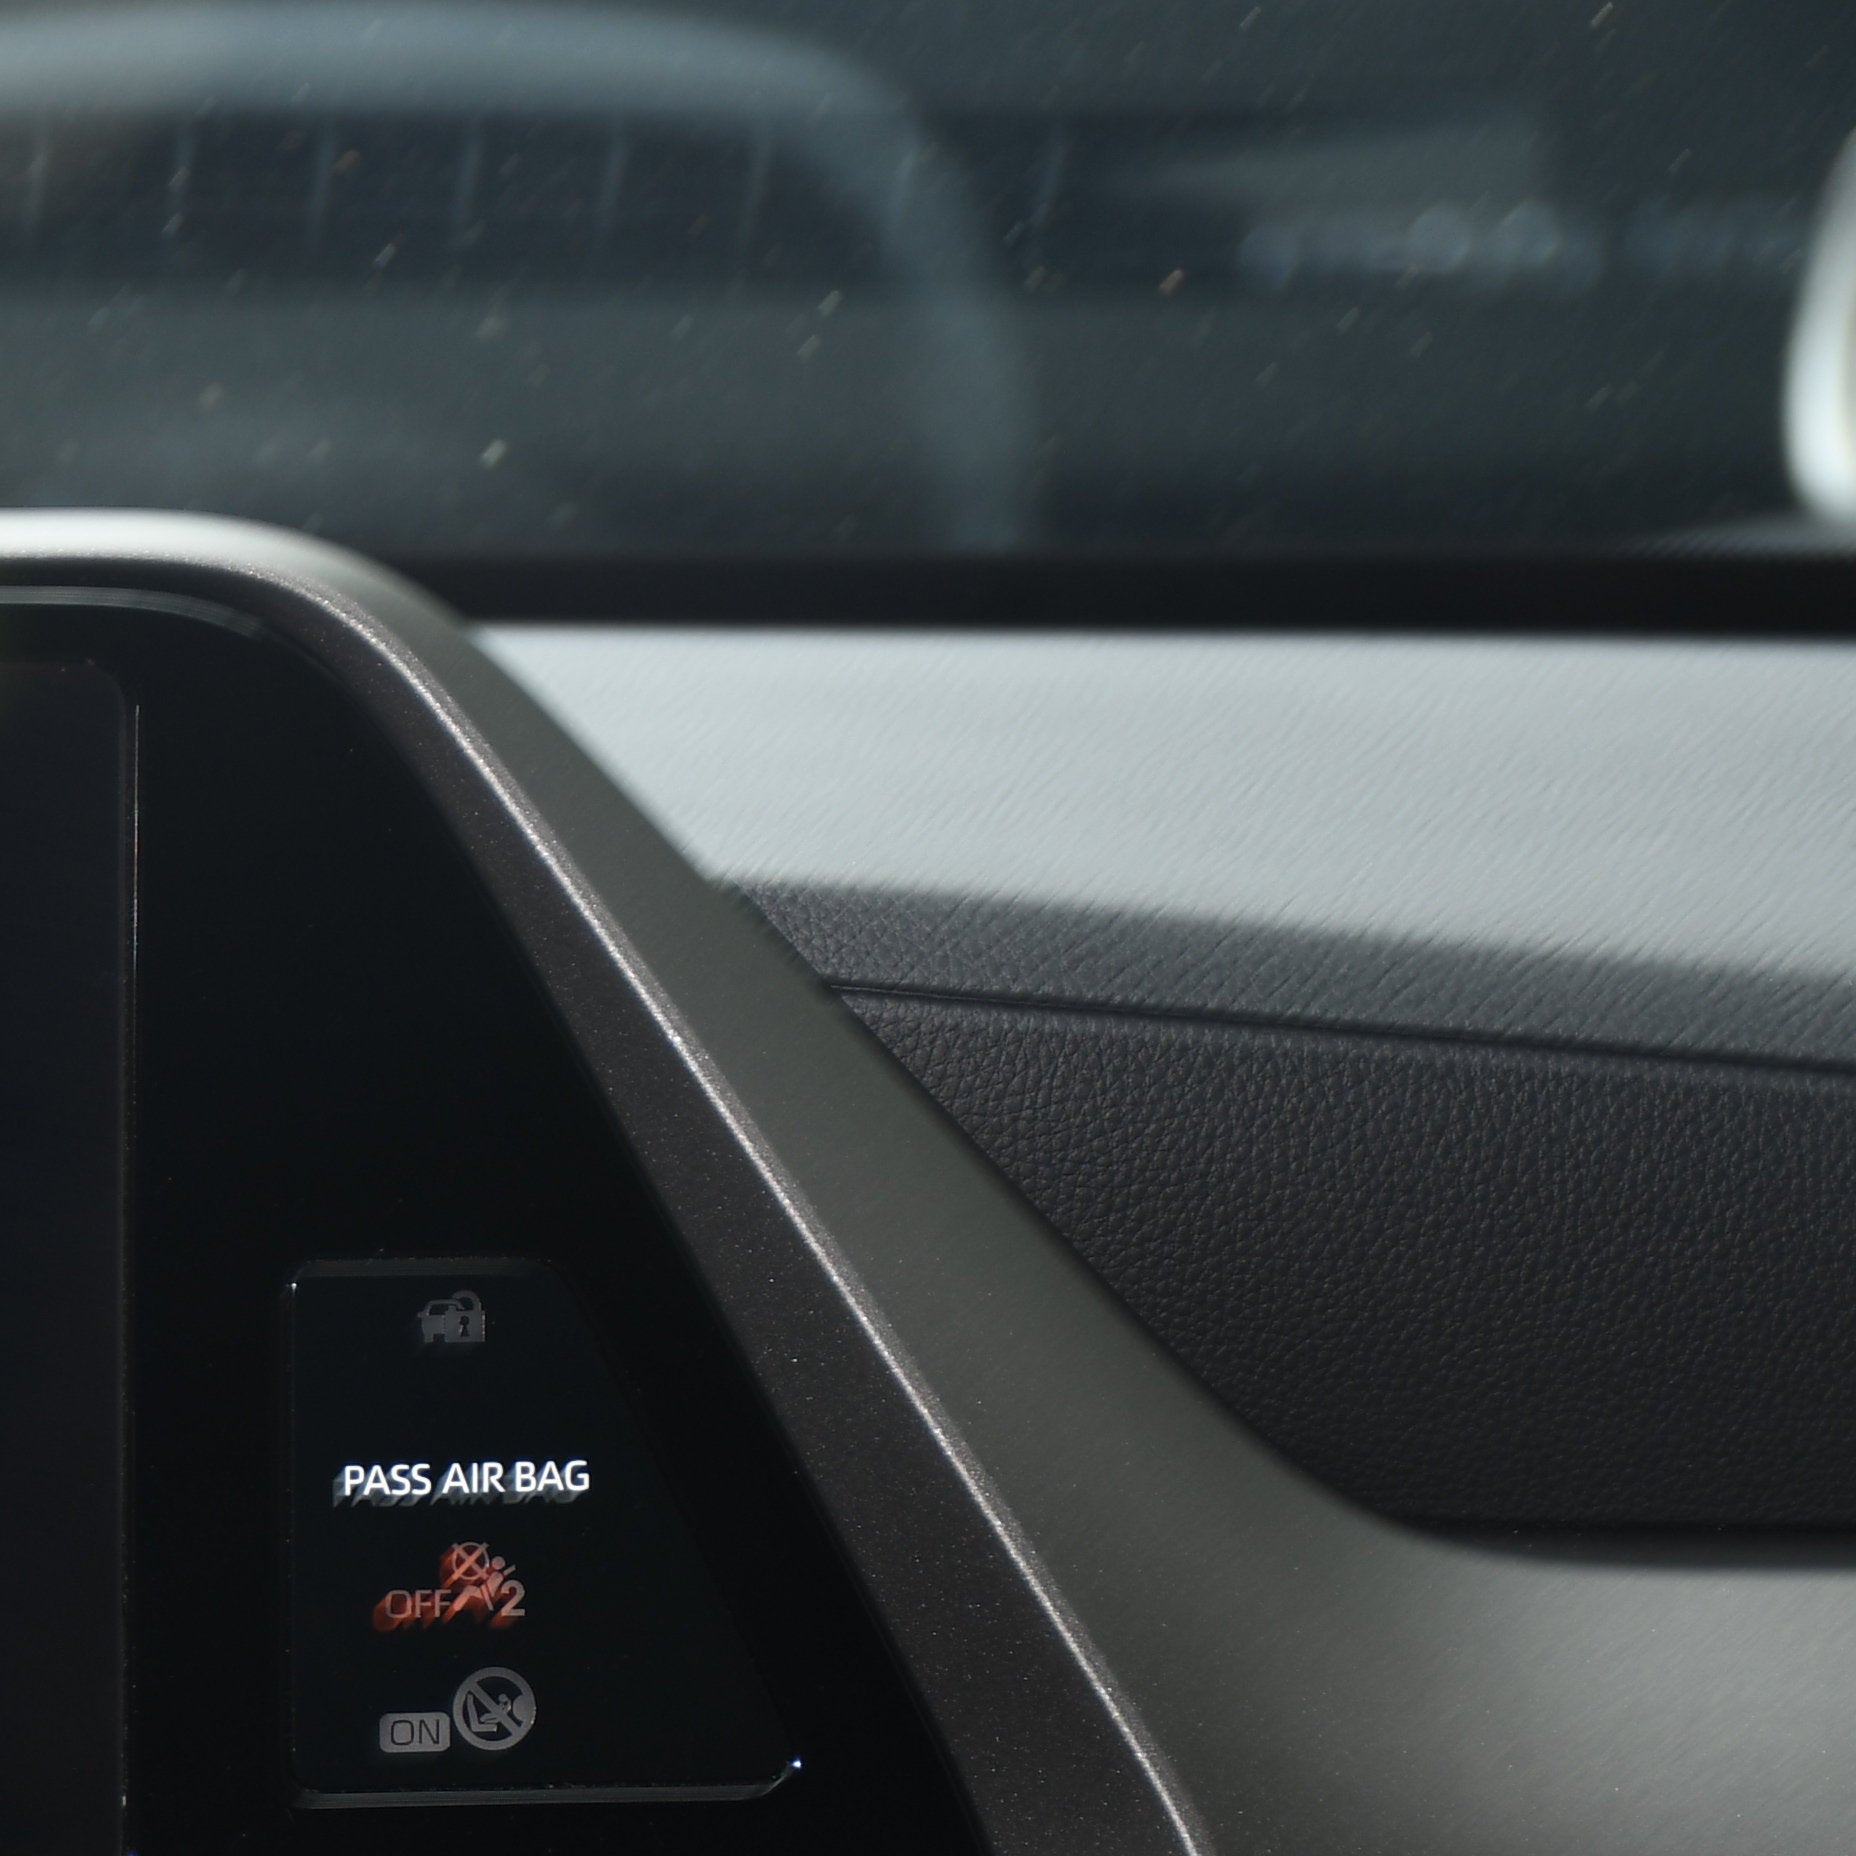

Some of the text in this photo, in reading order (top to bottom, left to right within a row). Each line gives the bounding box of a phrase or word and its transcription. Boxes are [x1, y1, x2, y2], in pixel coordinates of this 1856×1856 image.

[343, 1458, 590, 1498] PASS AIR BAG
[385, 1588, 453, 1619] OFF
[388, 1717, 442, 1748] ON
